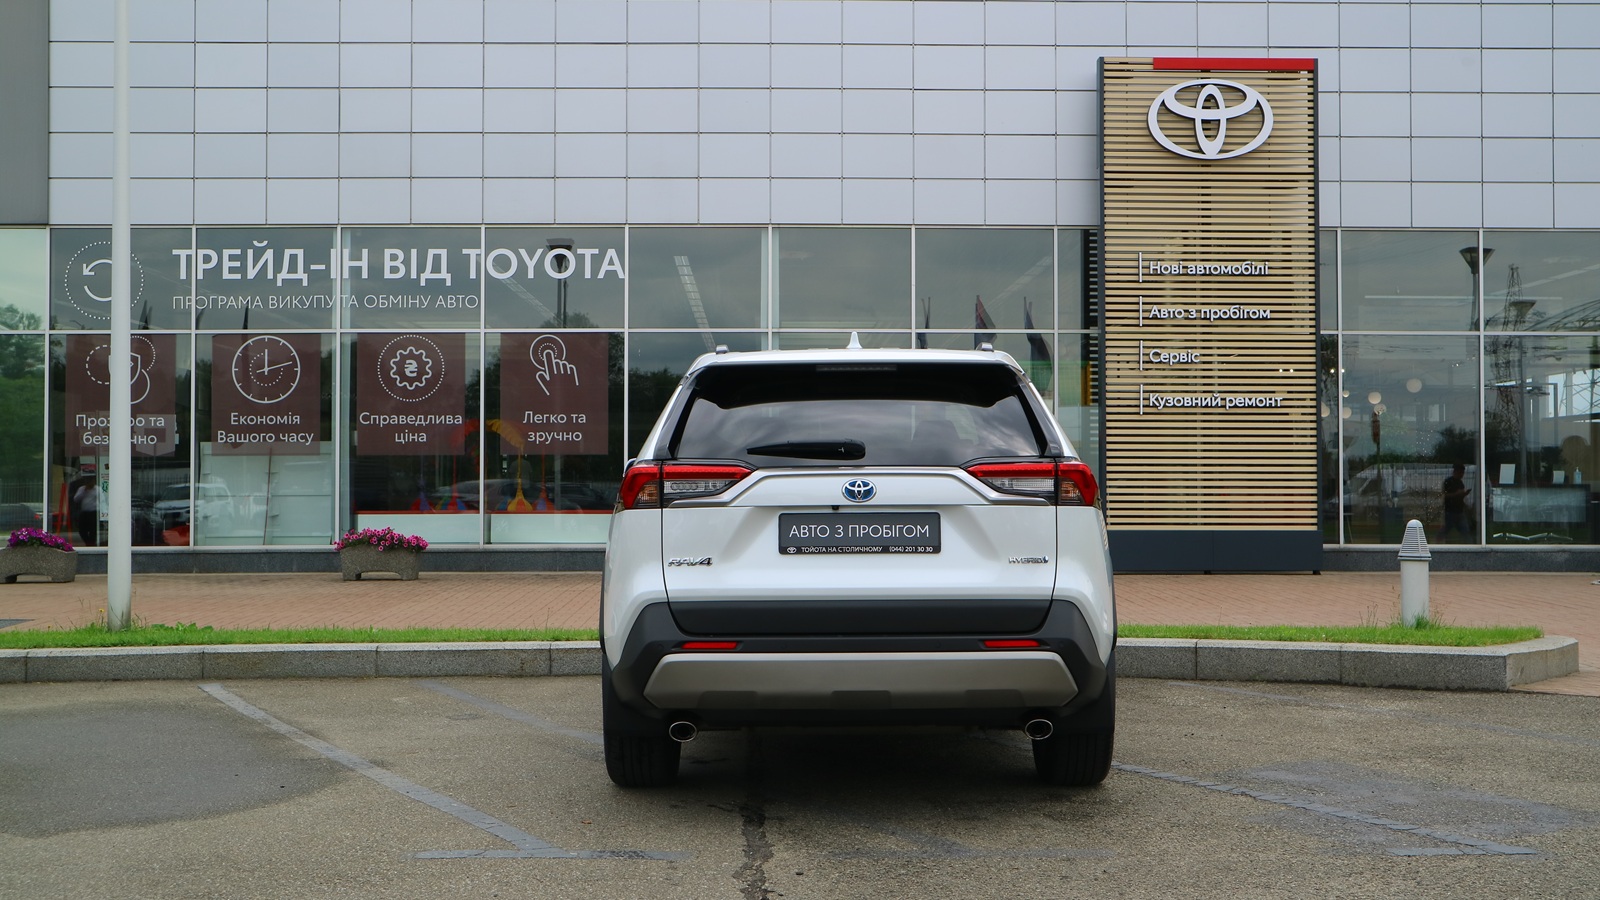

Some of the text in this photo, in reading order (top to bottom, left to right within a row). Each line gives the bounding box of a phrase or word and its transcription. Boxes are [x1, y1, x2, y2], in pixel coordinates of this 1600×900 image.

[172, 240, 625, 286] ТРЕЙД-ІН ВІД TOYOTA
[1149, 261, 1269, 275] Нові автомобілі
[172, 295, 479, 309] ПРОГРАМА ВИКУПУ ТА ОБМІНУ АВТО
[1149, 305, 1271, 322] Авто з пробігом
[1149, 350, 1200, 365] Сервіс
[1149, 393, 1283, 410] Кузовний ремонт
[149, 417, 165, 427] та
[230, 412, 301, 425] Економія
[359, 412, 463, 427] Справедлива
[523, 411, 586, 425] Легко та
[83, 431, 157, 445] безчно
[217, 430, 314, 446] Вашого часу
[395, 431, 427, 444] ціна
[527, 431, 582, 444] зручно
[789, 525, 930, 538] АВТО З ПРОБІГОМ
[668, 556, 713, 567] RAV4
[1009, 556, 1042, 564] HYBRID
